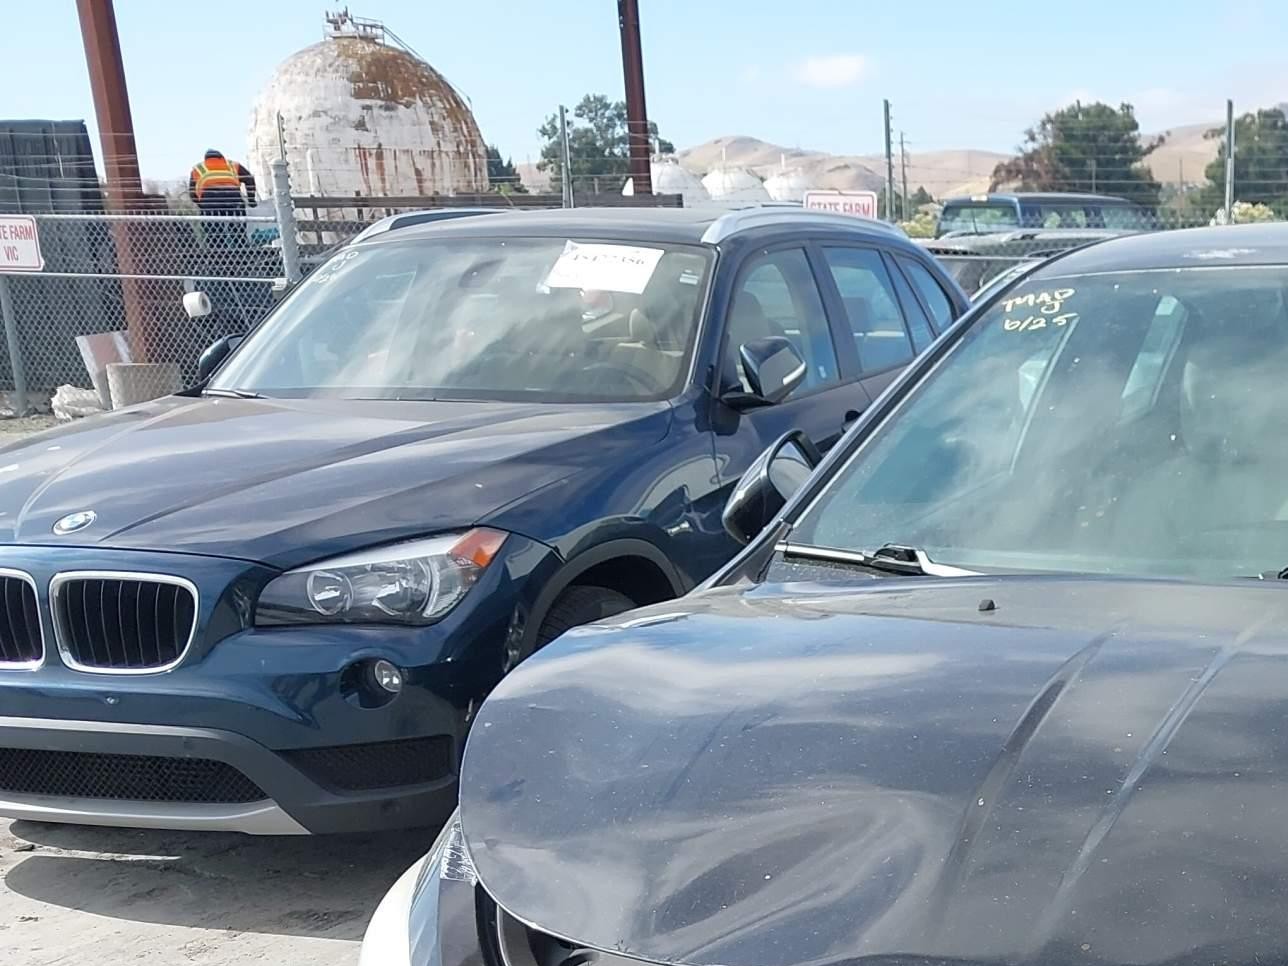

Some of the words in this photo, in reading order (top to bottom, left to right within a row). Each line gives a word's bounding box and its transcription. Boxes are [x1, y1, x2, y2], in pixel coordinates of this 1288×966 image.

[843, 202, 870, 216] FARM
[9, 224, 34, 241] FARM
[3, 245, 19, 261] VIC
